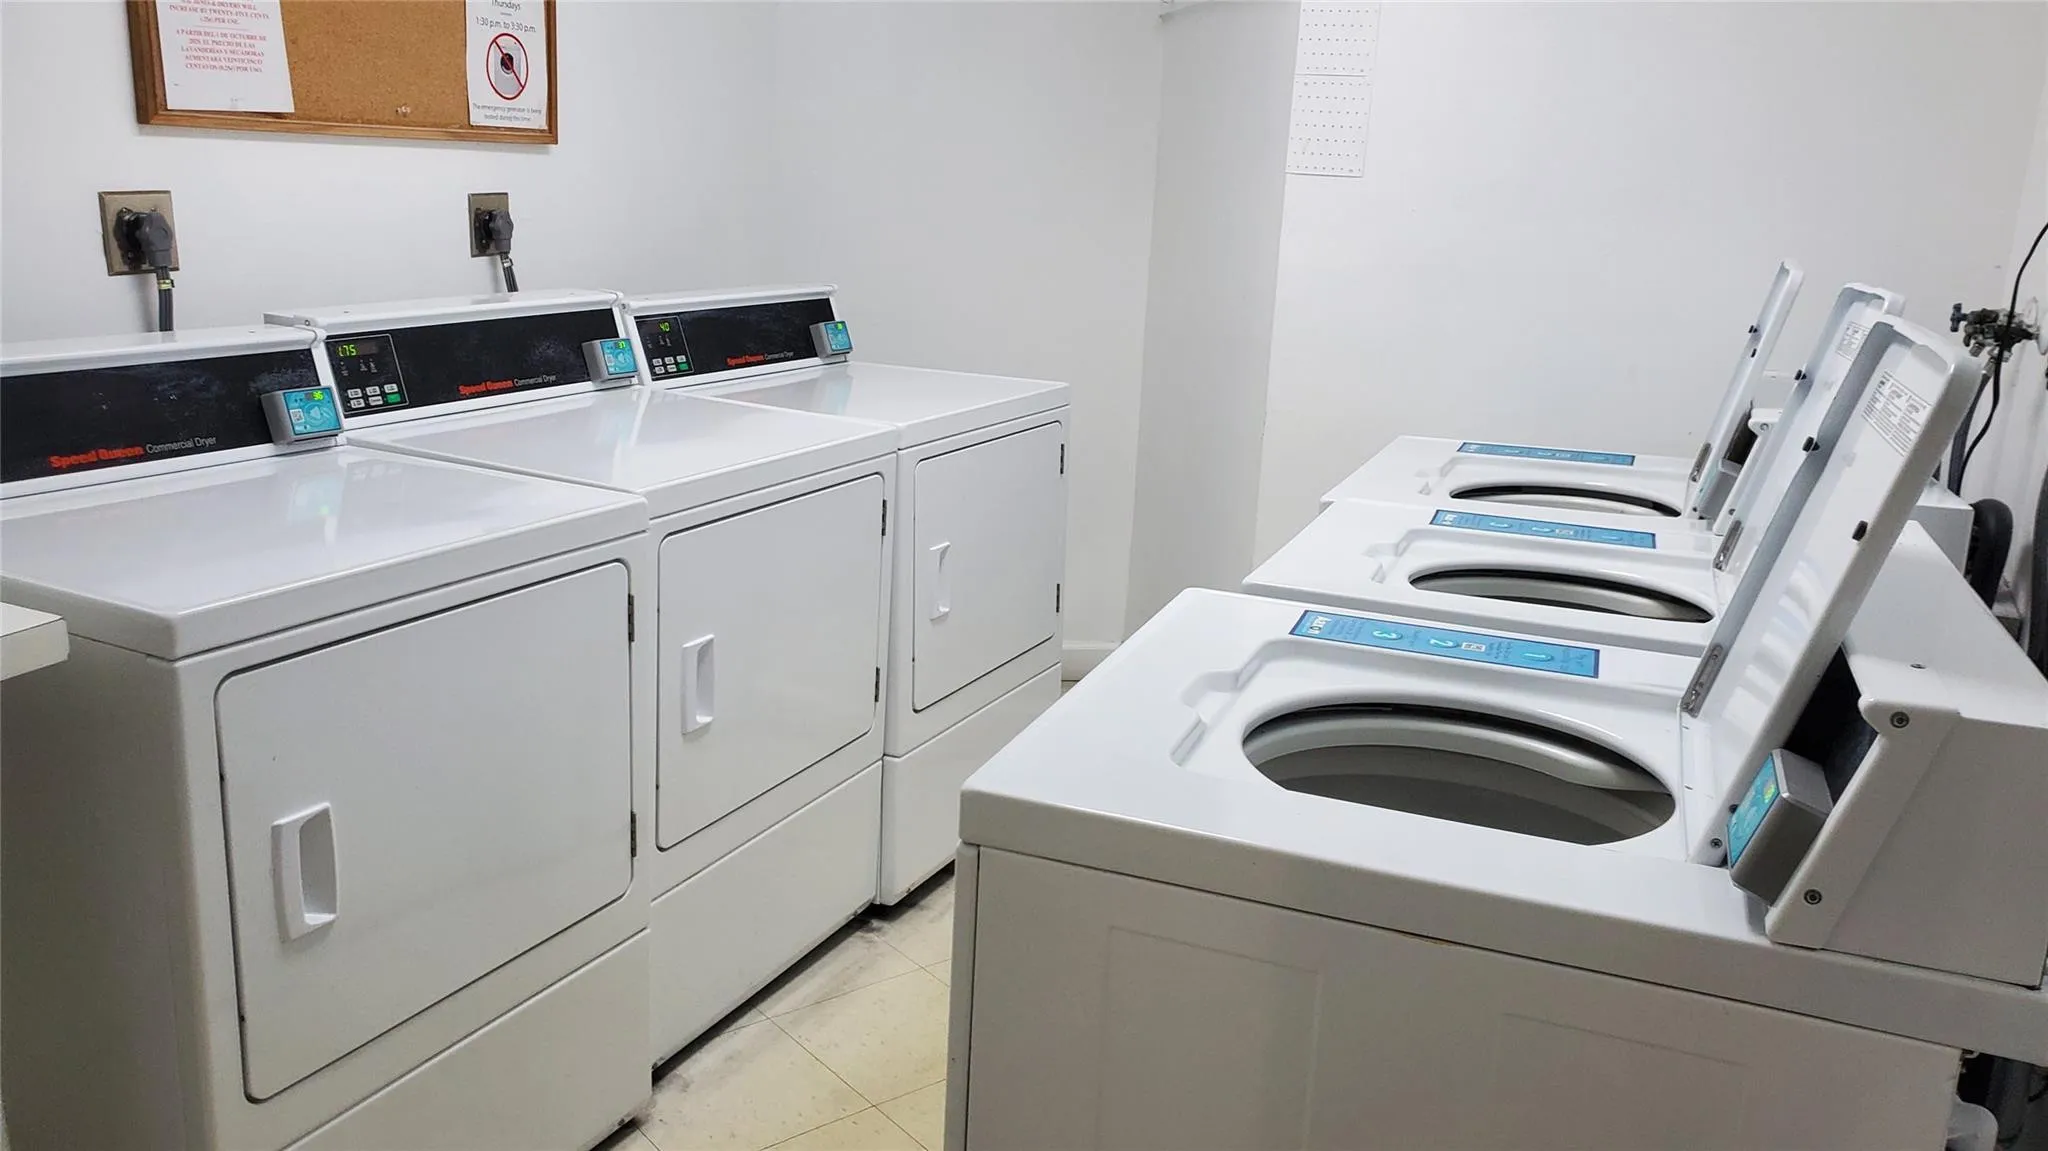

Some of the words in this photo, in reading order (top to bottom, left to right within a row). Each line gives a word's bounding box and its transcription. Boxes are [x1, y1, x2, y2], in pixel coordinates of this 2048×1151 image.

[503, 21, 510, 30] to
[660, 322, 670, 332] 40
[458, 382, 486, 396] Speed
[514, 378, 542, 386] Commercial
[543, 374, 556, 384] Dryer
[50, 450, 98, 468] Speed
[98, 446, 144, 460] Queen
[146, 438, 194, 454] Commercial
[194, 436, 217, 450] Dryer
